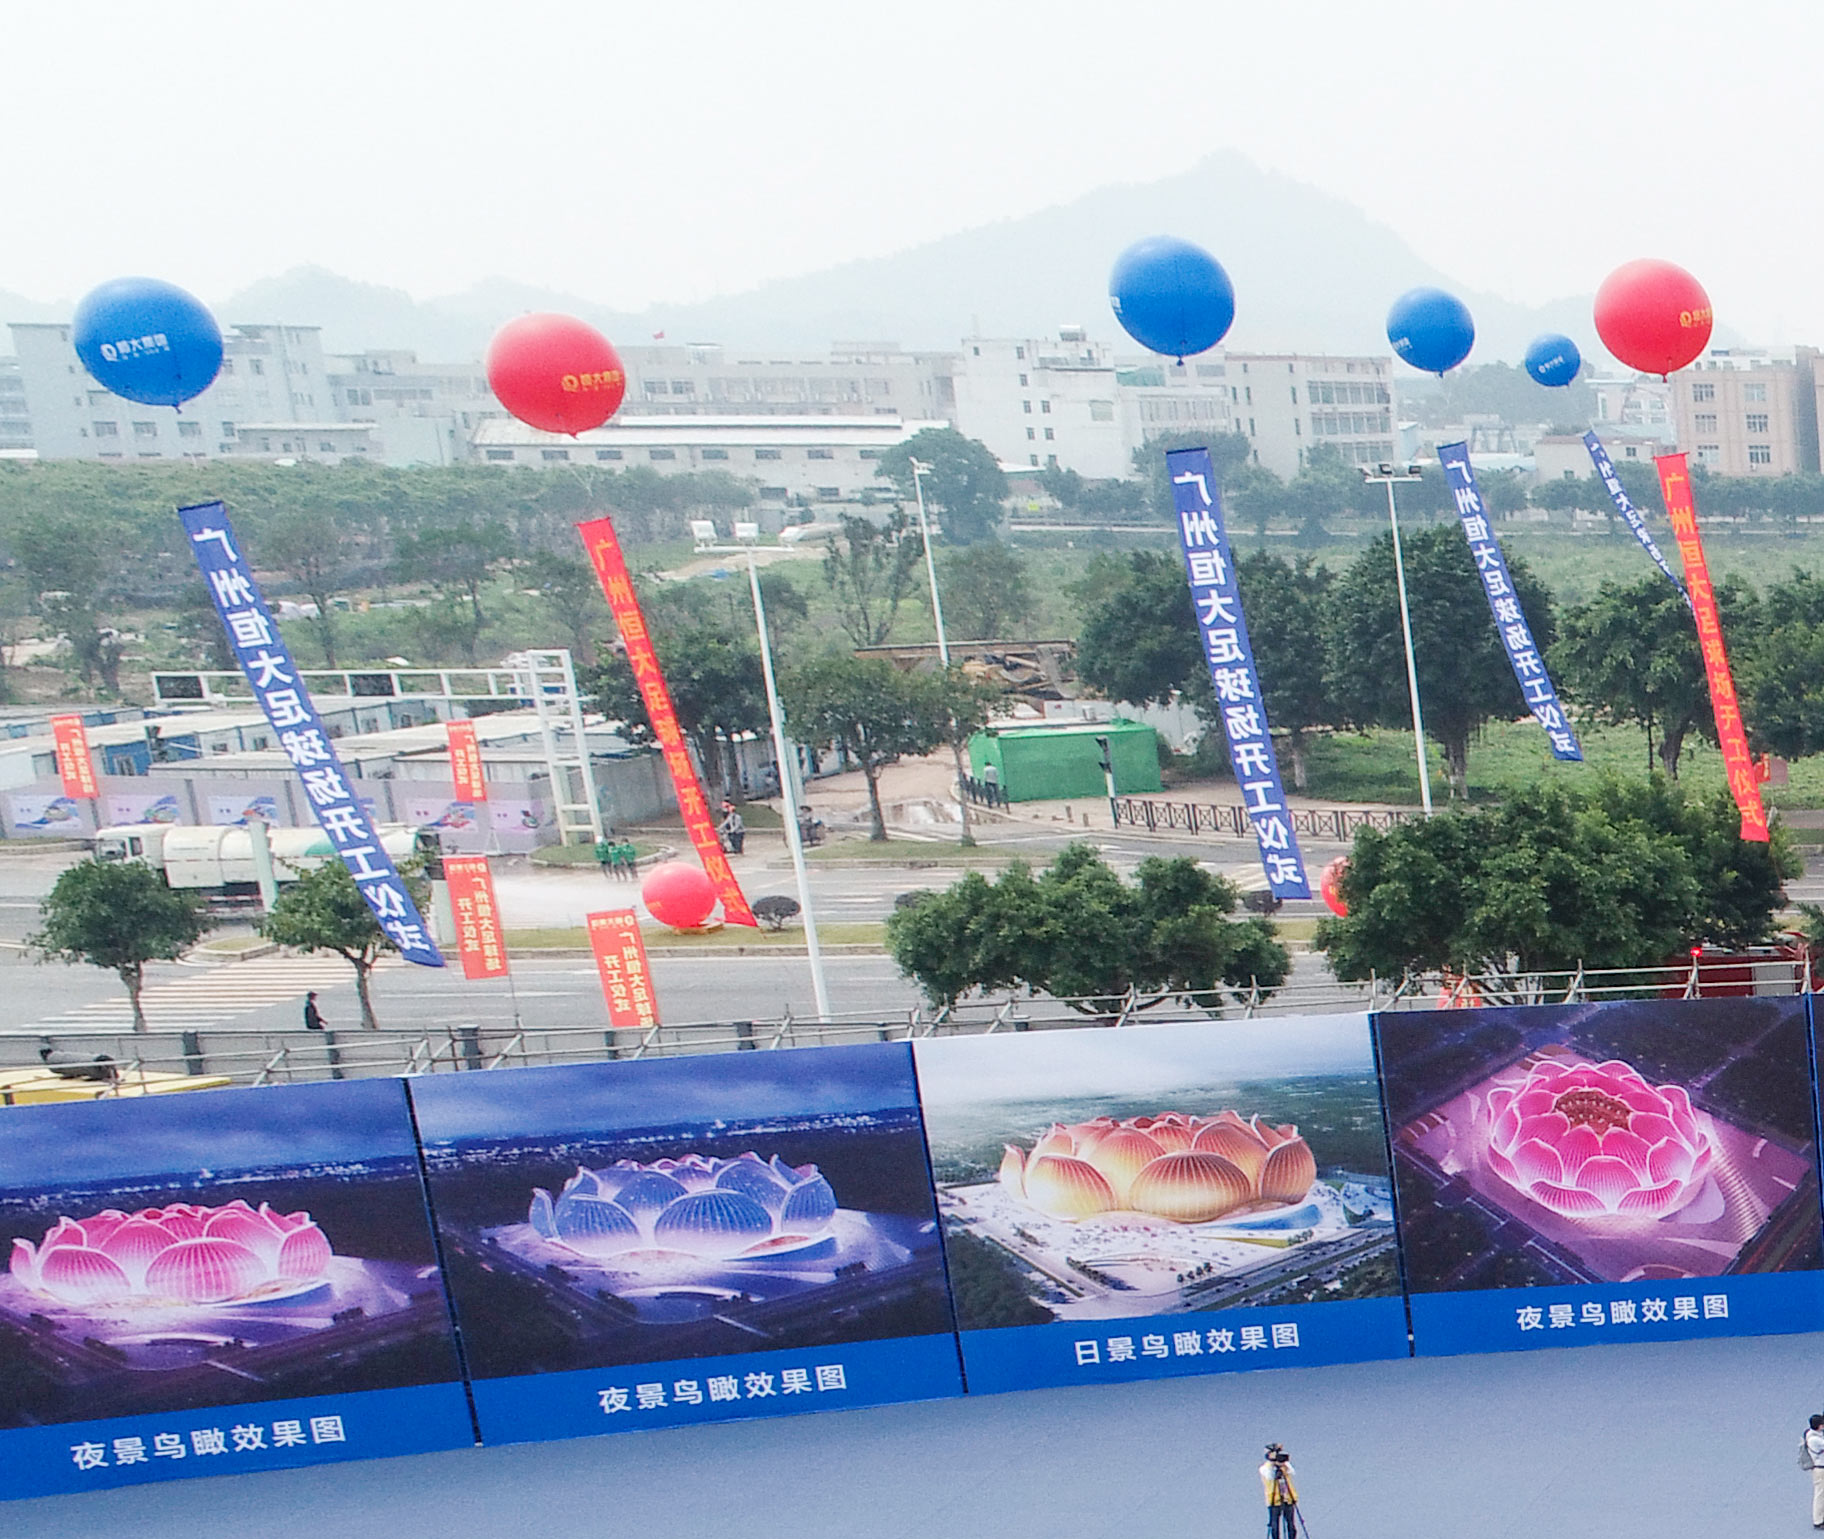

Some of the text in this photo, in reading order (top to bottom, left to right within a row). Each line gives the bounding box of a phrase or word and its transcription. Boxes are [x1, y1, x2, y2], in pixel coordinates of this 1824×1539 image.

[1665, 472, 1763, 827] 广州恒大足球场开工仪式
[592, 538, 751, 916] 广州恒大足球场开工仪式
[1516, 1294, 1729, 1332] 夜景鸟瞰效果图
[1074, 1322, 1300, 1367] 日景鸟瞰效果图
[598, 1363, 848, 1414] 夜景鸟瞰效果图
[71, 1415, 346, 1471] 夜景鸟瞰效果图
